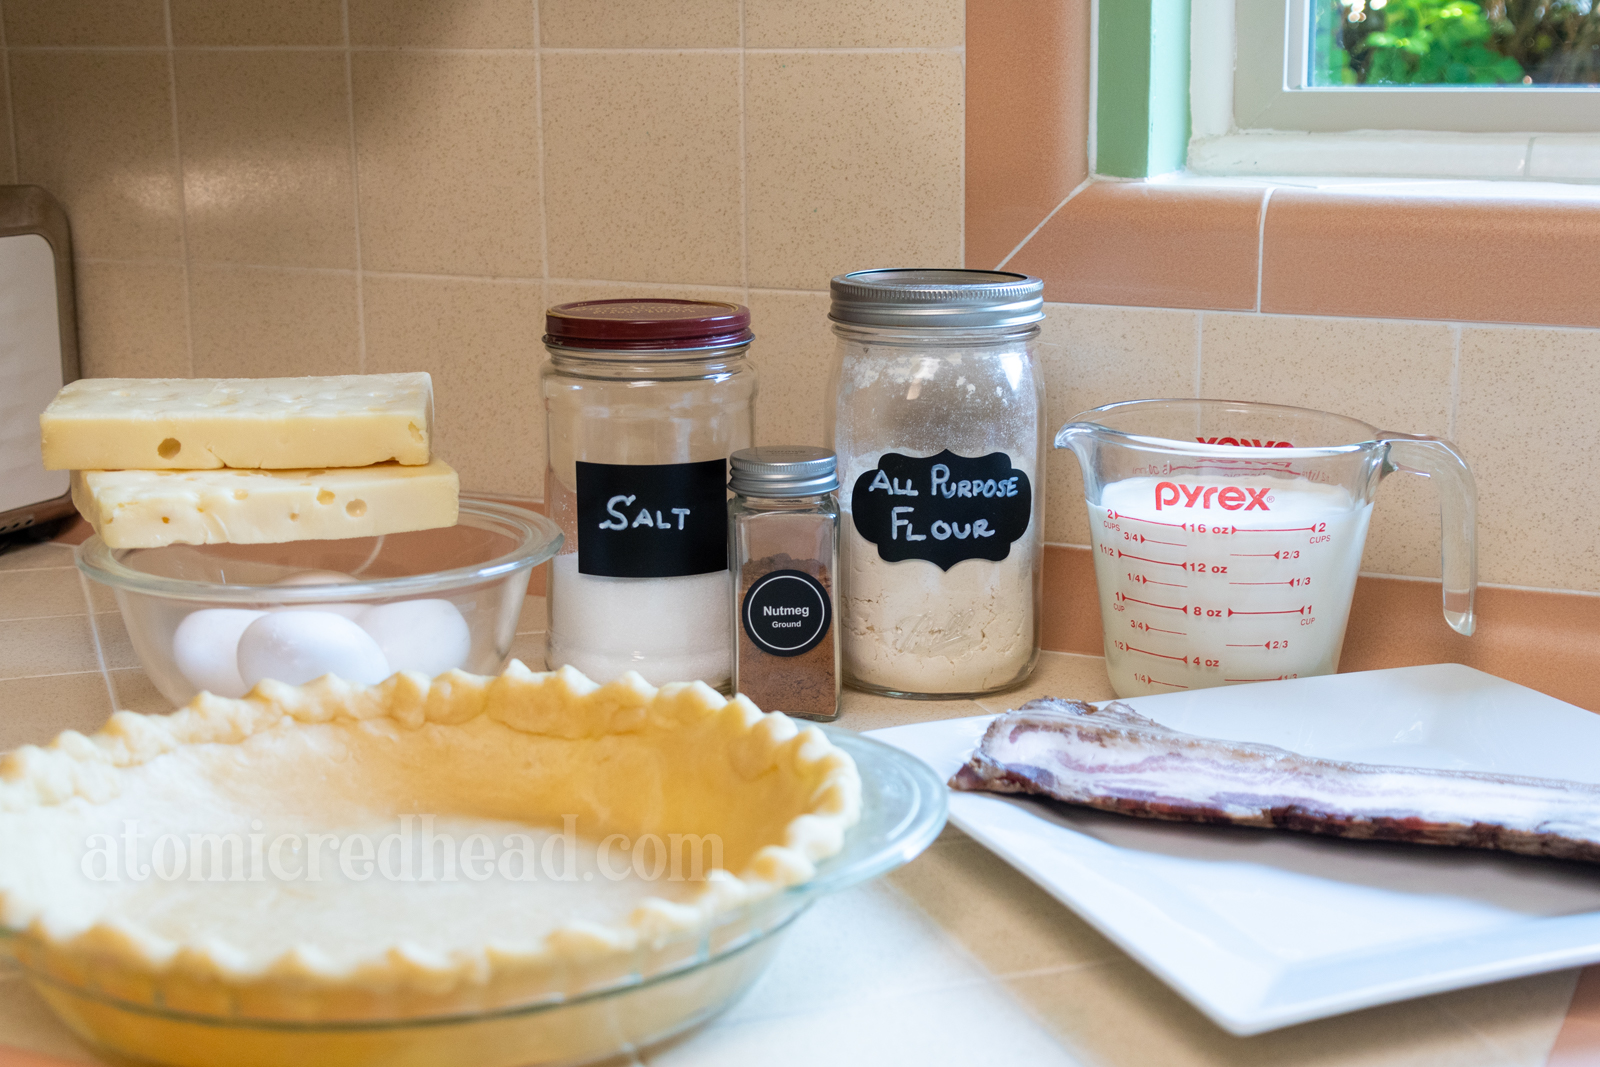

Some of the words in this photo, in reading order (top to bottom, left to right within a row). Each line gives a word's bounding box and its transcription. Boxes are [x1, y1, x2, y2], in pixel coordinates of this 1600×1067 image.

[868, 469, 919, 497] ALL
[930, 463, 1019, 499] PURPOSE
[1154, 481, 1271, 511] pyrex
[599, 494, 690, 531] SALT
[1107, 508, 1114, 520] 2
[891, 506, 996, 541] FLOUR
[1103, 520, 1121, 532] CUPS
[1189, 523, 1207, 534] 16
[1211, 526, 1229, 535] oz
[1317, 522, 1327, 533] 2
[1123, 531, 1139, 543] 3/4
[1308, 534, 1331, 545] CUPS
[1282, 550, 1300, 560] 2/3
[1189, 562, 1207, 573] 12
[1211, 565, 1228, 574] oz
[1127, 572, 1141, 583] 1/4
[1295, 576, 1311, 587] 1/3
[1115, 591, 1121, 602] 1
[763, 605, 809, 618] Nutmeg
[1113, 602, 1126, 613] CUP
[1193, 606, 1202, 617] 8
[1206, 609, 1222, 618] oz
[1307, 604, 1313, 615] 1
[771, 620, 802, 629] Ground
[1130, 619, 1144, 631] 3/4
[1300, 617, 1316, 627] CUP
[1114, 640, 1125, 651] 1/2
[1272, 640, 1289, 650] 2/3
[1192, 656, 1201, 667] 4
[1205, 658, 1220, 668] oz
[1133, 673, 1147, 684] 1/4
